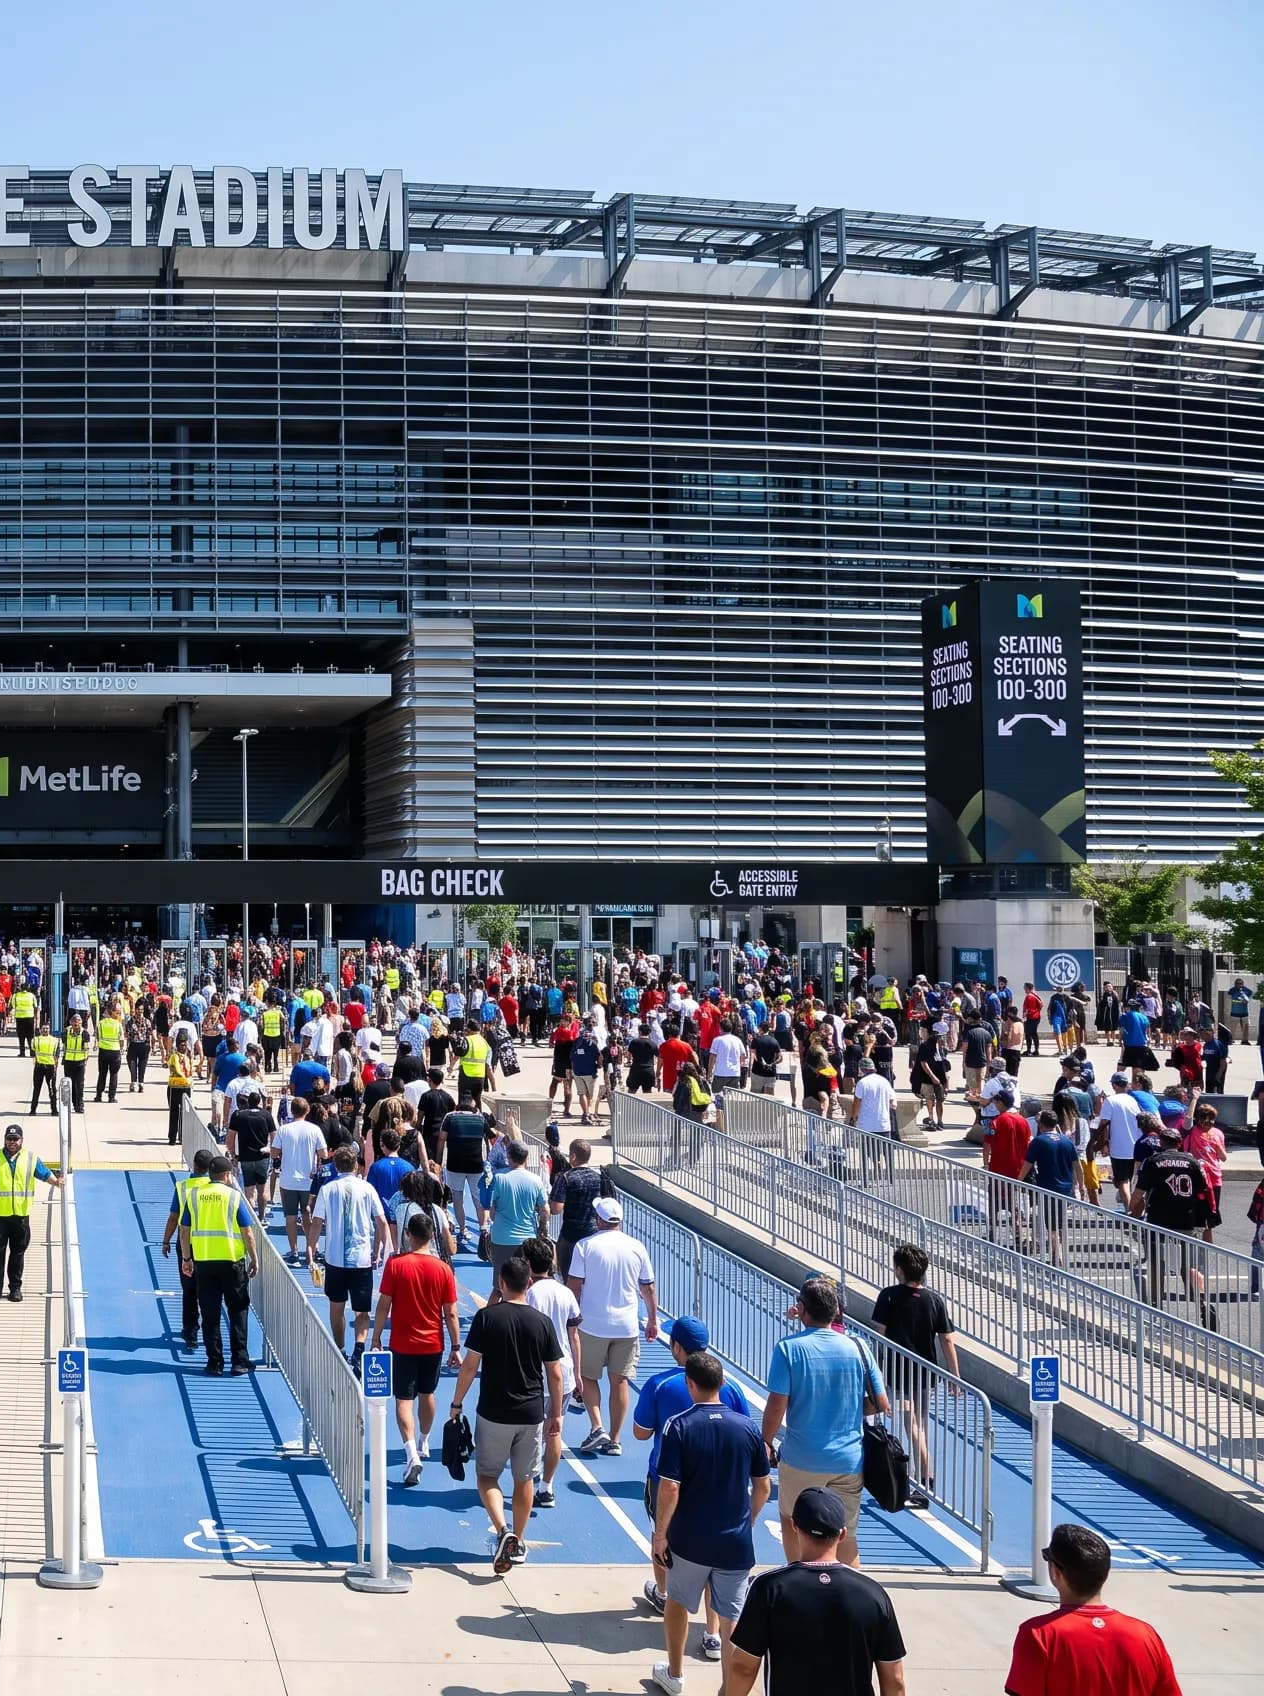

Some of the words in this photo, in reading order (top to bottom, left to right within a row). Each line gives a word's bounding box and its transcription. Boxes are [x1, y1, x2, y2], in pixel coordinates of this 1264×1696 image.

[67, 164, 404, 251] STADIUM
[933, 641, 968, 666] SEATING
[999, 636, 1062, 654] SEATING
[931, 661, 973, 687] SECTIONS
[994, 657, 1067, 676] SECTIONS
[931, 682, 972, 711] 100-300
[996, 679, 1067, 700] 100-300
[19, 764, 142, 792] MetLife
[381, 869, 424, 896] BAG
[430, 869, 504, 896] CHECK
[738, 869, 799, 883] ACCESSIBLE
[739, 884, 763, 897] GATE
[766, 884, 798, 897] ENTRY
